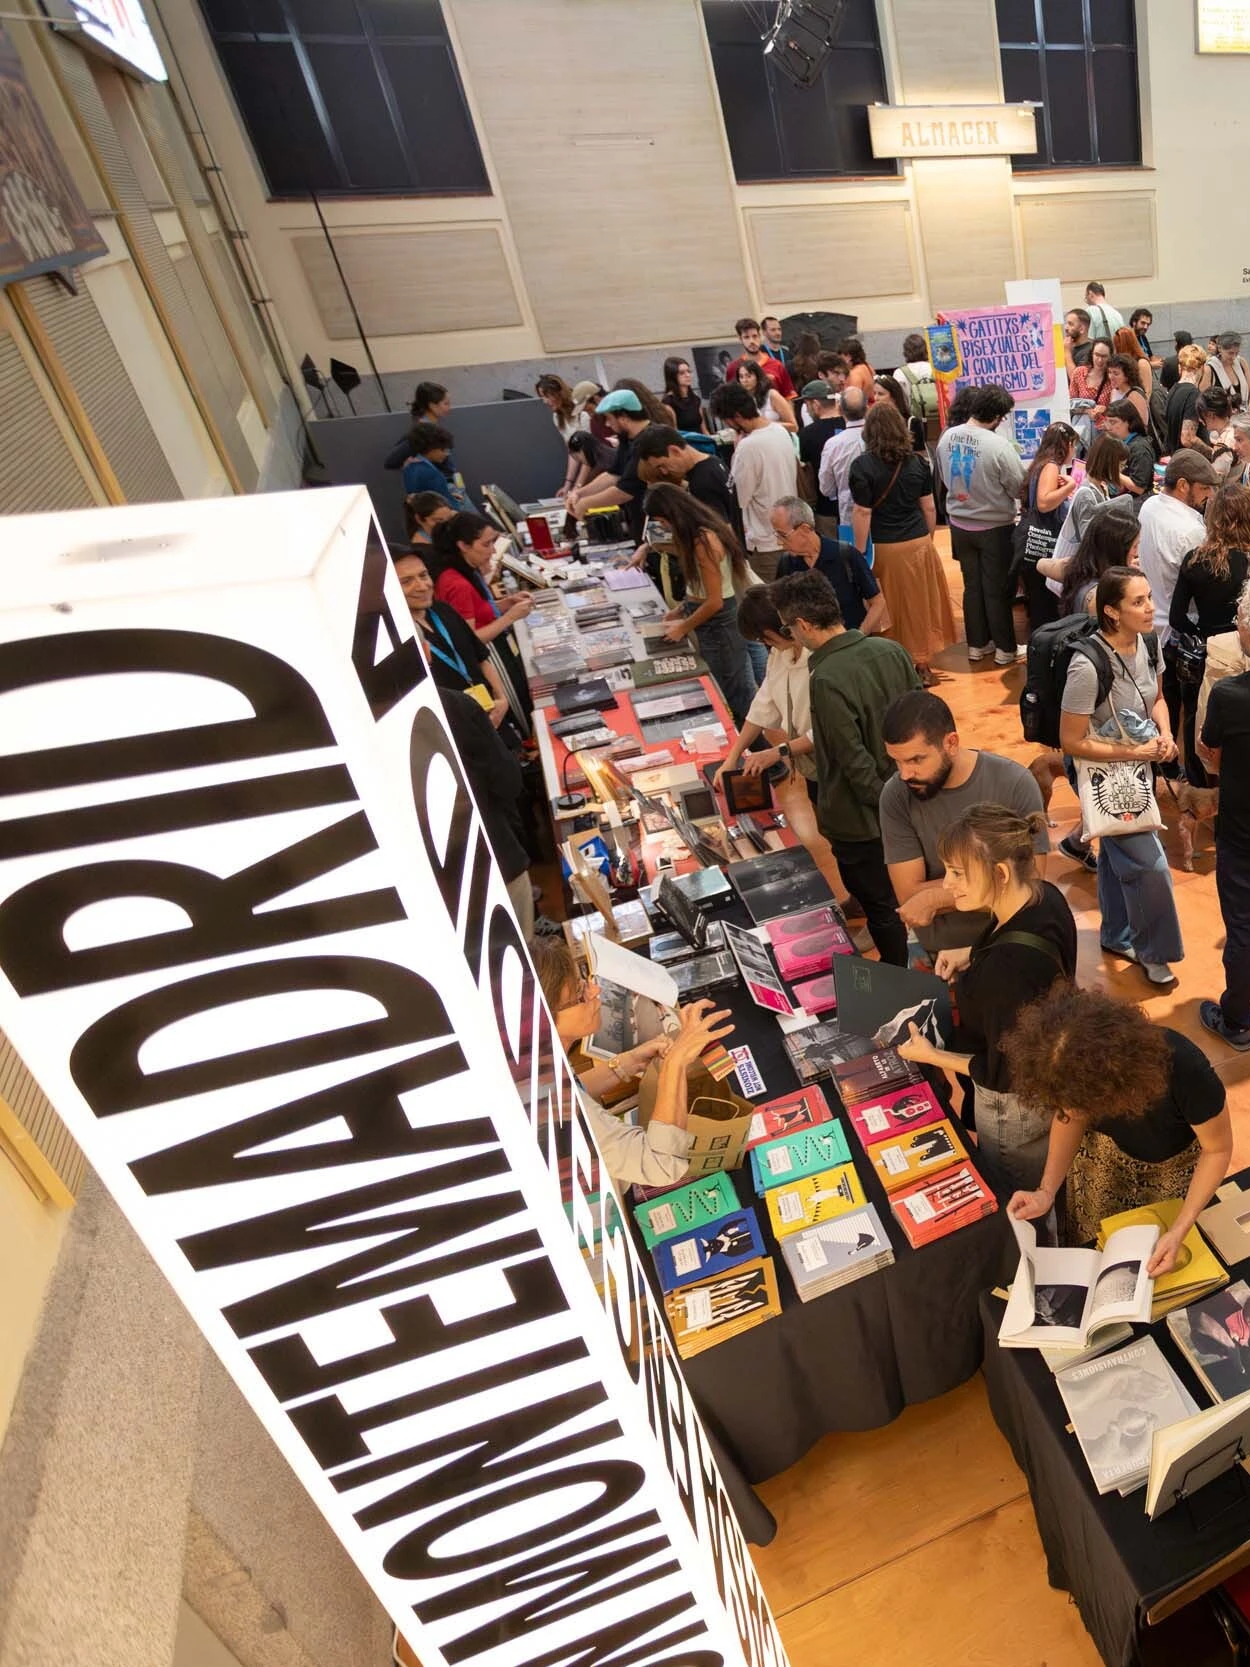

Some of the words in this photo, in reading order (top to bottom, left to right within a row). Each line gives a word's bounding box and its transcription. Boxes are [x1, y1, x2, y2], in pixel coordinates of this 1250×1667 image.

[902, 120, 1000, 147] ALMACEN
[968, 317, 1020, 339] GATITXS
[960, 334, 1031, 358] BISEXUALES
[960, 360, 970, 377] N
[972, 356, 1018, 376] CONTRA
[1020, 352, 1042, 370] DEL
[737, 1062, 755, 1094] ZIONISTS
[0, 628, 682, 1665] MONTEMADRID
[1069, 1344, 1147, 1382] CONTRAVISIONES
